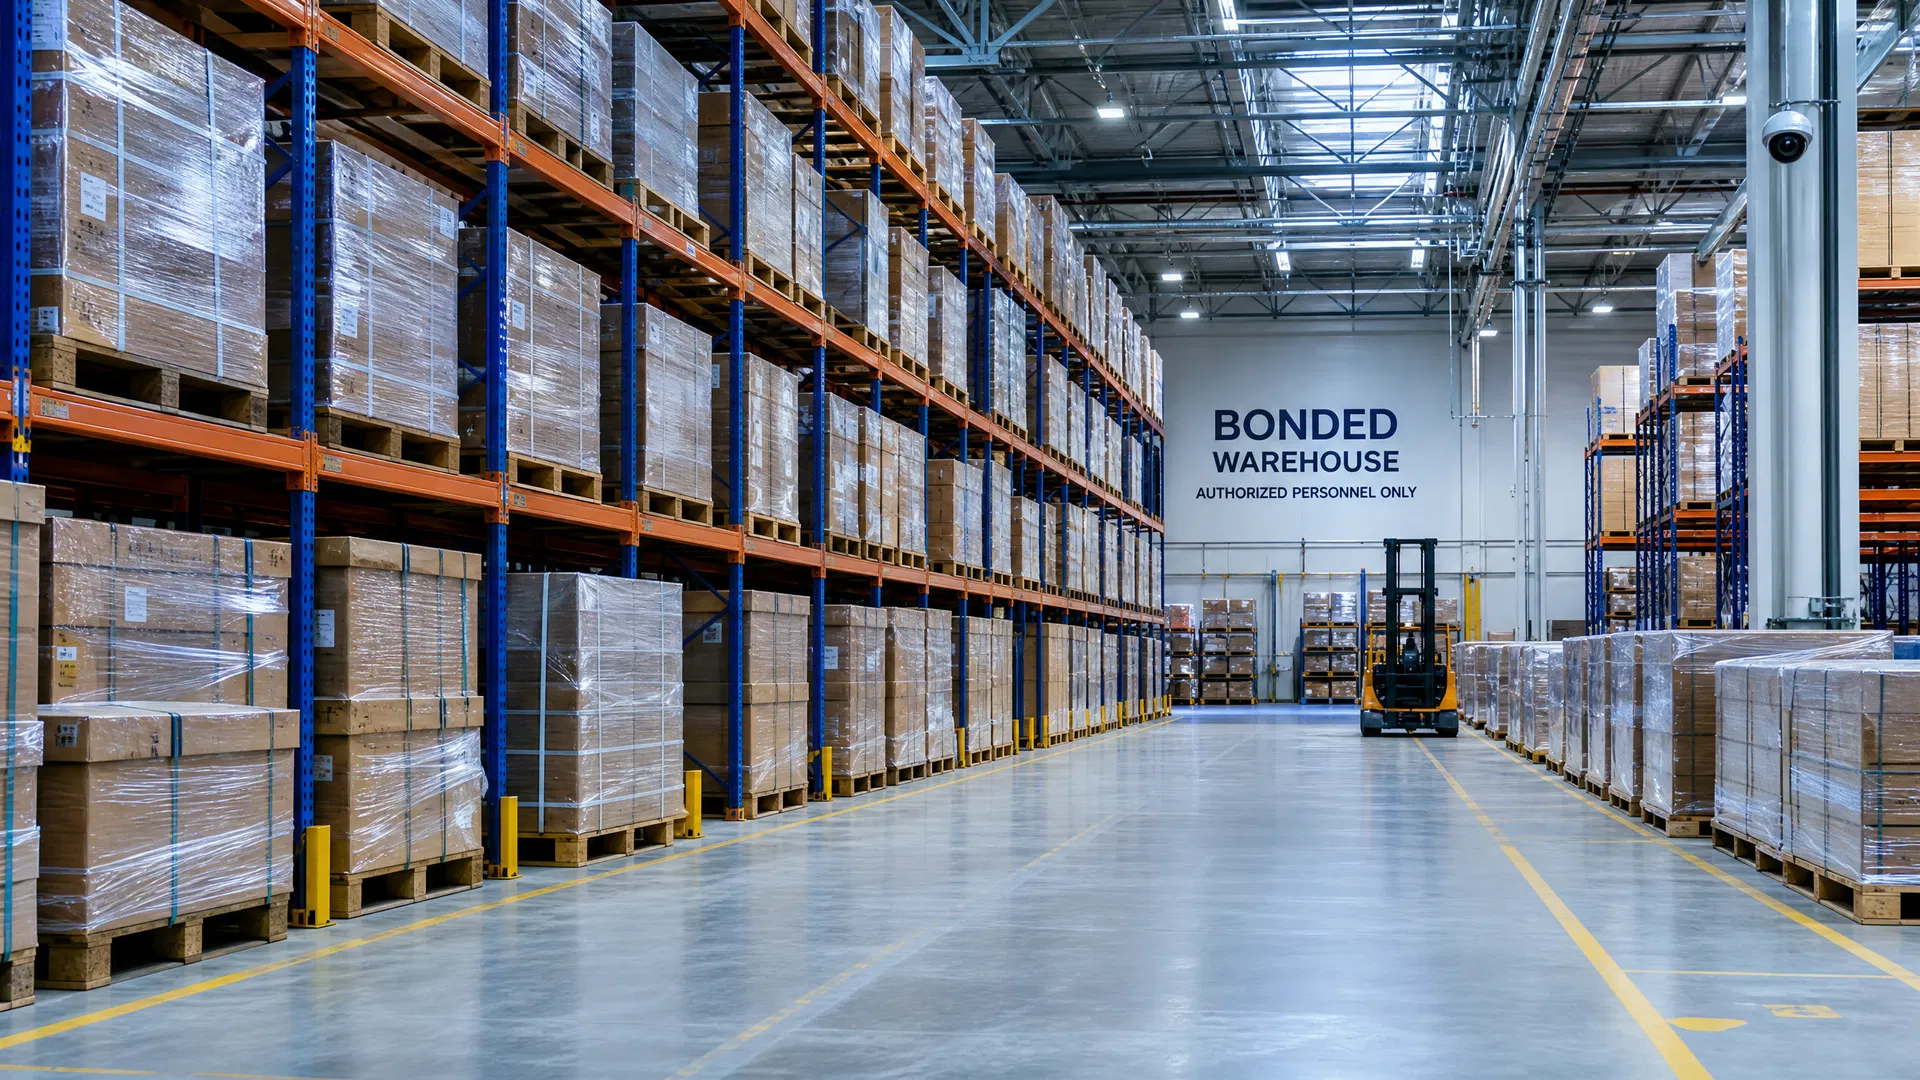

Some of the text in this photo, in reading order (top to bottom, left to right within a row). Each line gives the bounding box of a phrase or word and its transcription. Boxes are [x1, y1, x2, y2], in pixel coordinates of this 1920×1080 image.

[1214, 408, 1398, 441] BONDED
[1212, 450, 1400, 473] WAREHOUSE
[1196, 486, 1417, 499] AUTHORIZED PERSONNEL ONLY
